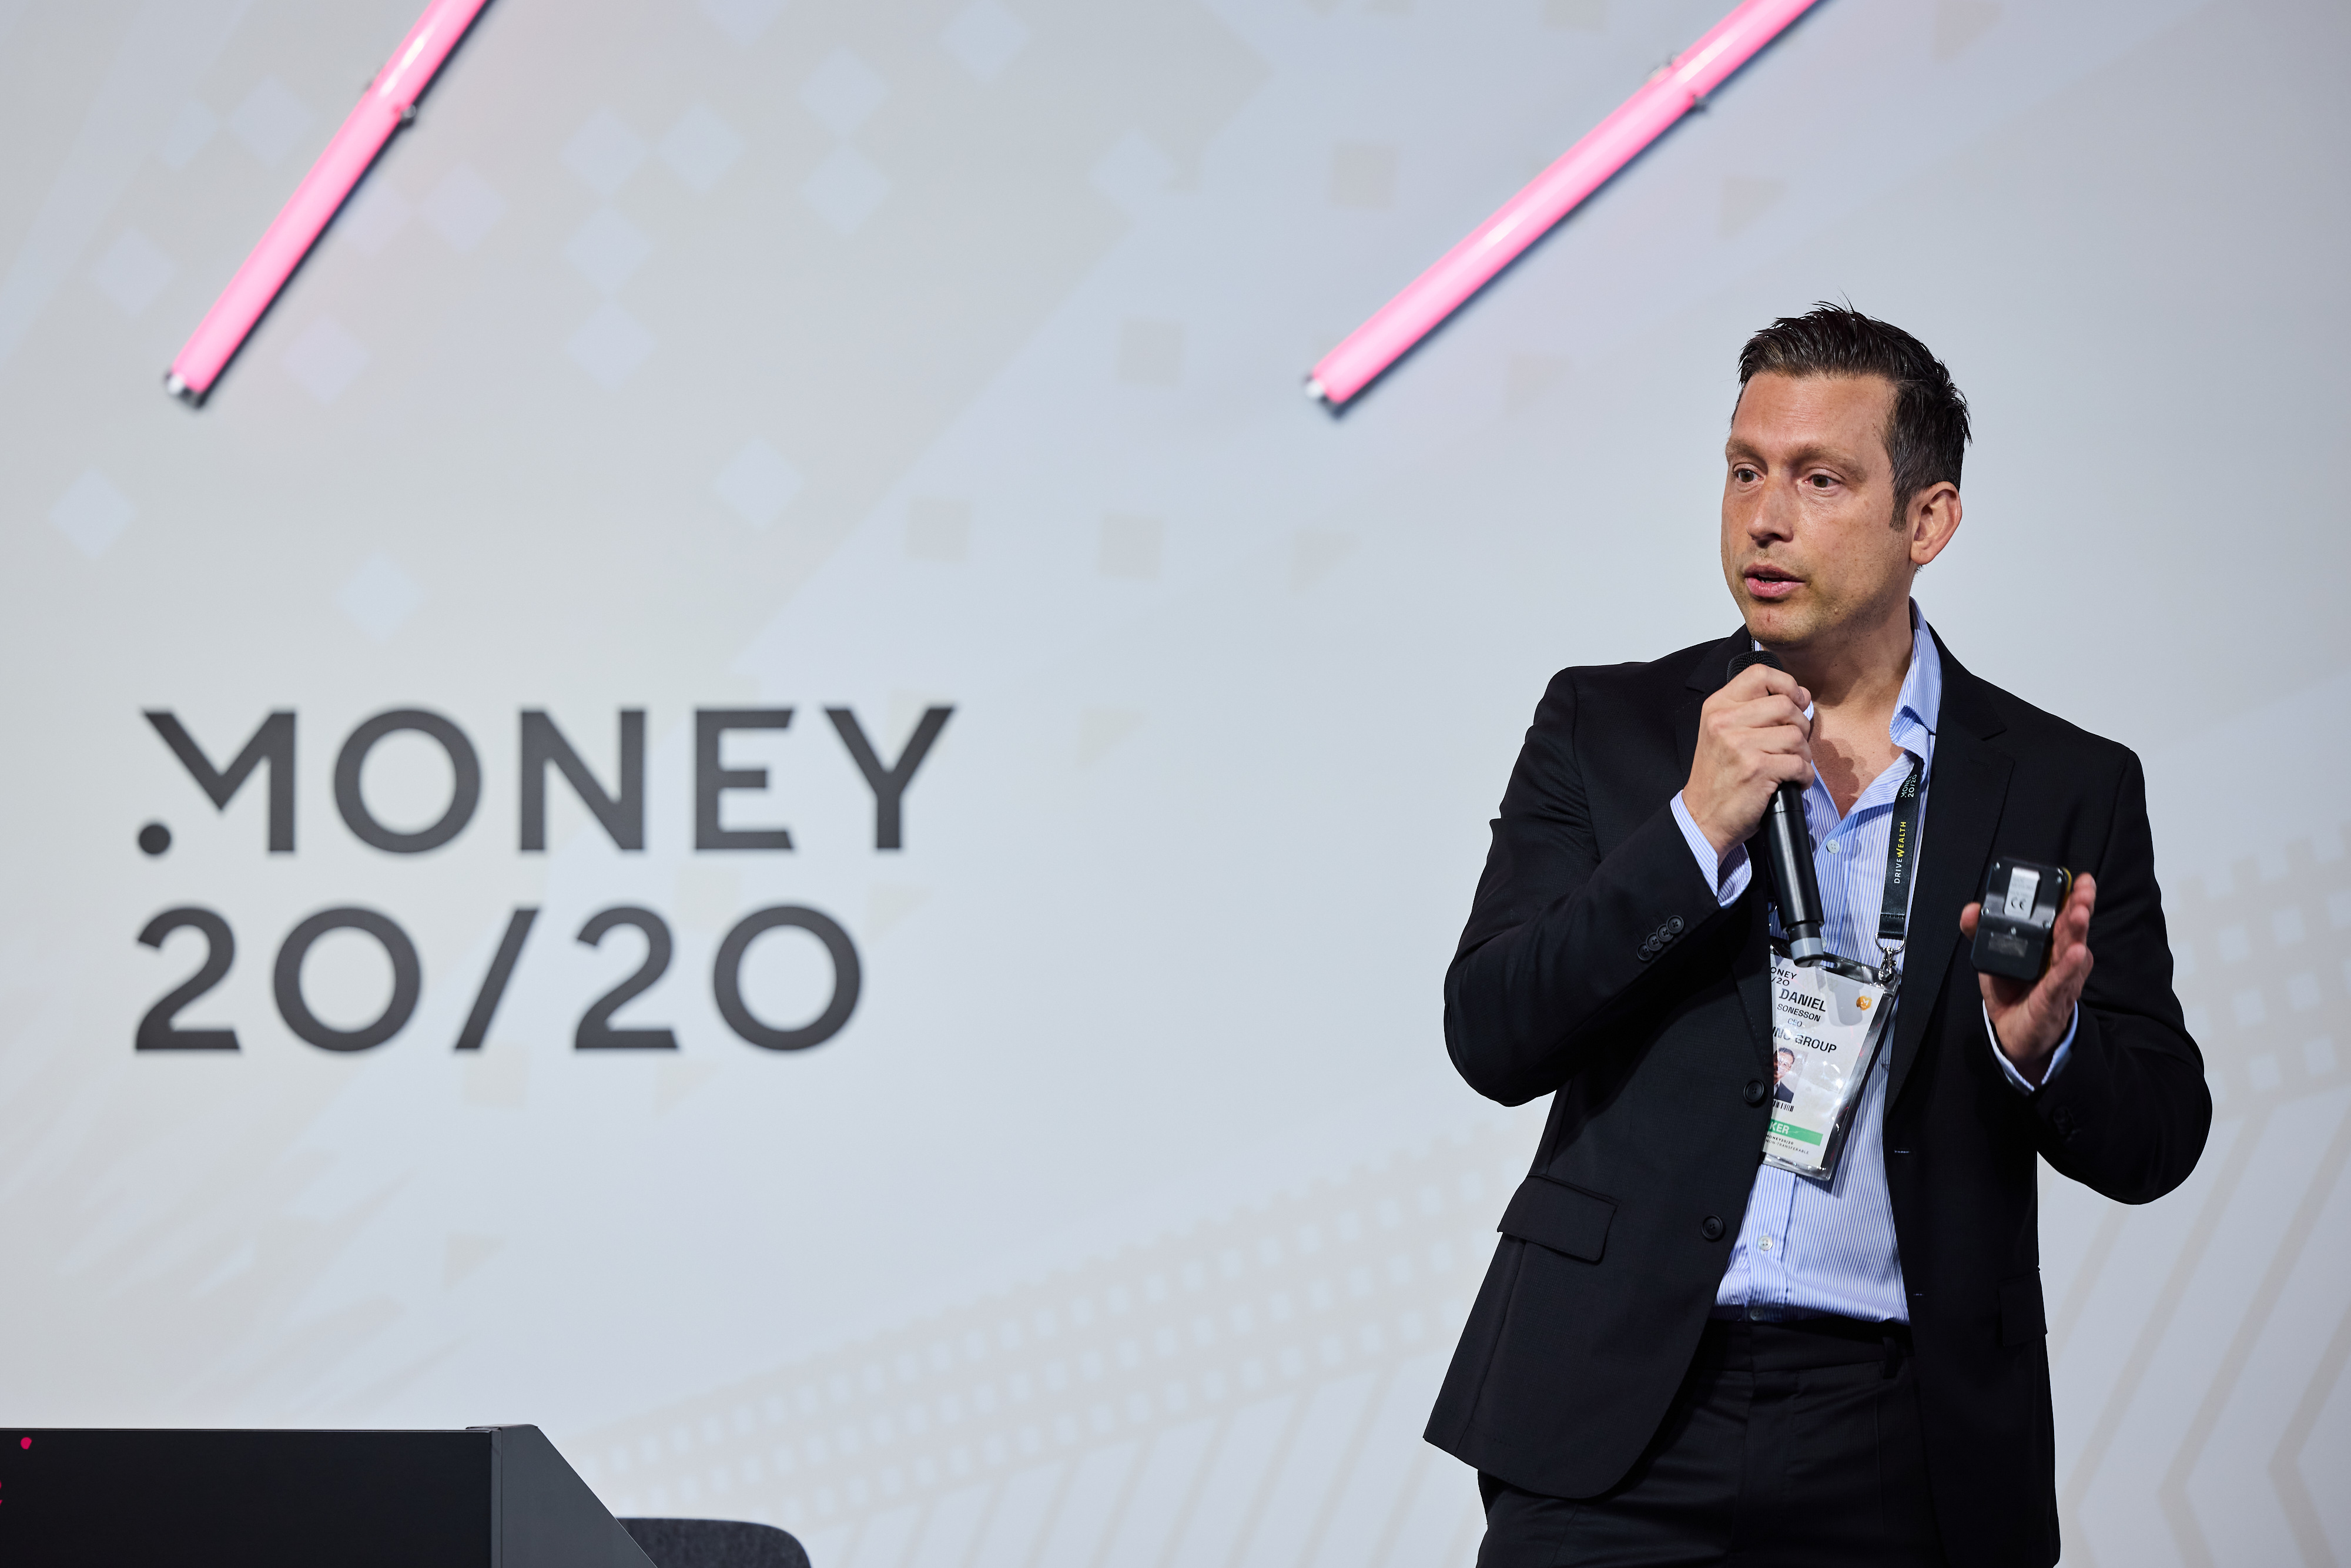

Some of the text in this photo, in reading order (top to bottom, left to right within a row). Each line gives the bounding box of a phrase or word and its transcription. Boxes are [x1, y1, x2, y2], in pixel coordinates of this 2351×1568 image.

[136, 706, 955, 857] MONEY
[1907, 774, 1917, 798] 20/20
[134, 905, 862, 1053] 20/20
[1770, 966, 1797, 980] ONEY
[1771, 976, 1790, 986] /20
[1779, 988, 1826, 1012] DANIEL
[1777, 1003, 1821, 1022] SONESSON
[1787, 1018, 1803, 1027] CEO
[1795, 1034, 1837, 1053] GROUP
[1769, 1121, 1790, 1135] KER
